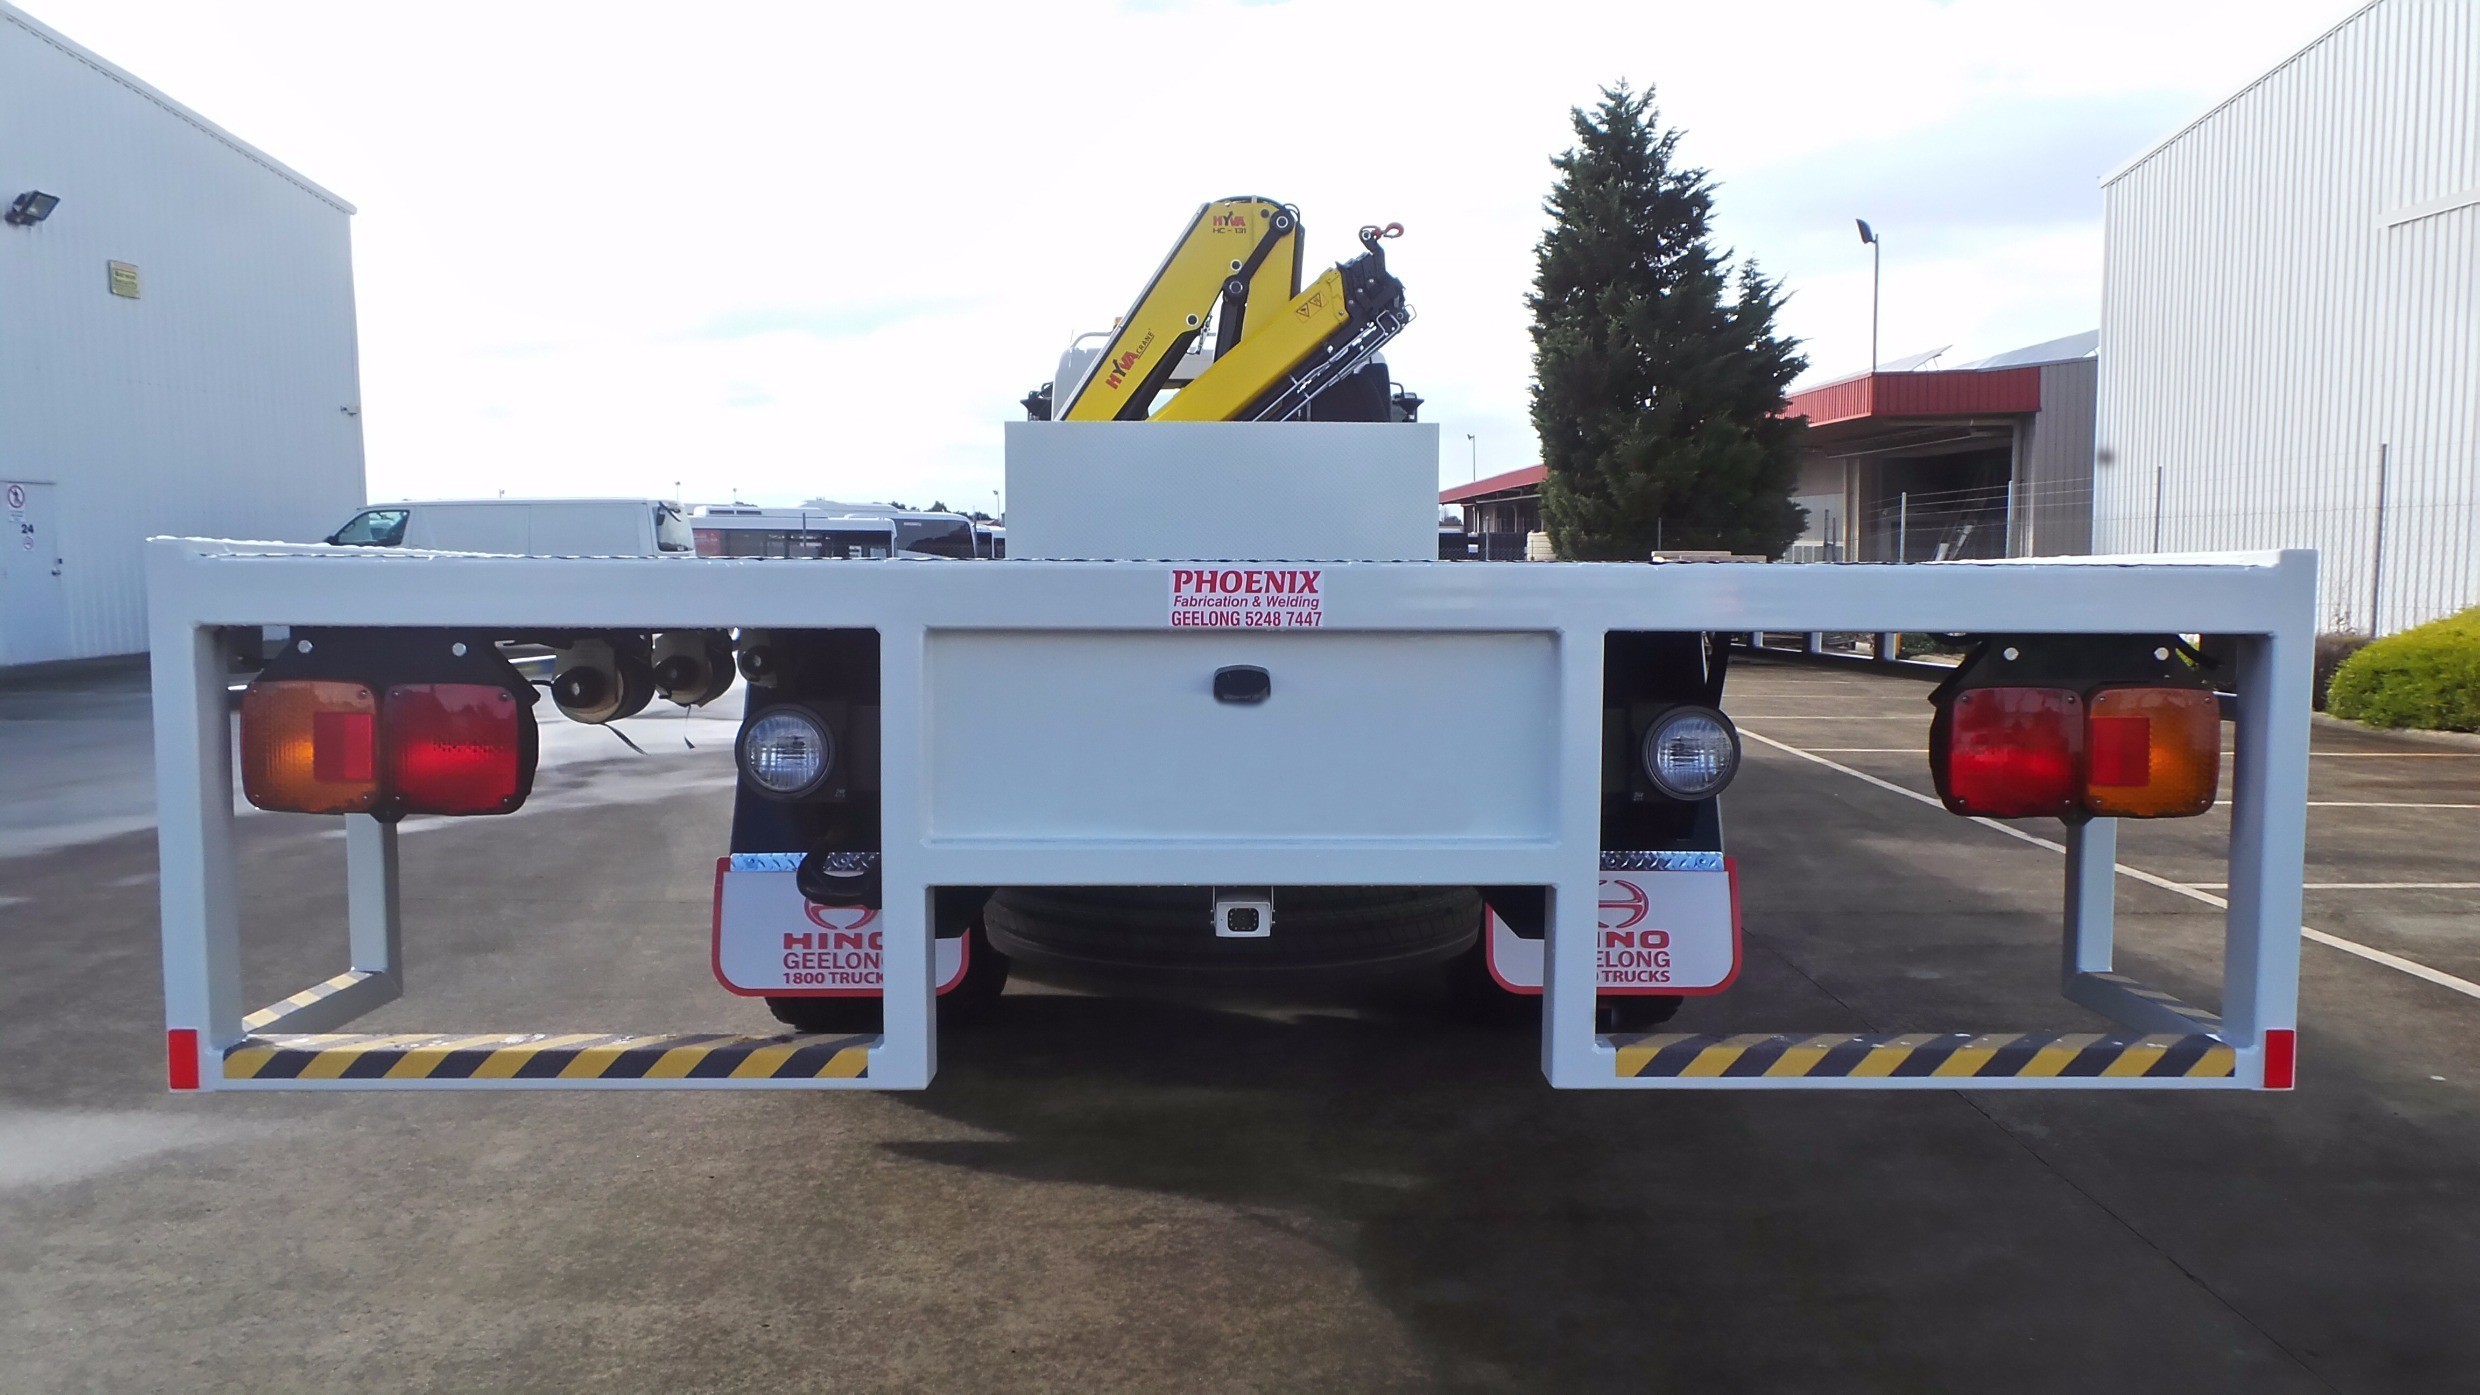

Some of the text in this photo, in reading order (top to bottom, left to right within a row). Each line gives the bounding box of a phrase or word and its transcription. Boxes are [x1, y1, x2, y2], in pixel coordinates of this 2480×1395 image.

[1213, 211, 1246, 226] HYVA
[1105, 330, 1154, 390] HYVA CRANE
[21, 523, 34, 534] 24
[1172, 570, 1322, 594] PHOENIX
[1173, 595, 1320, 610] Fabrication & Welding
[1171, 610, 1322, 627] GEELONG 5248 7447
[1597, 930, 1670, 949] NO
[783, 952, 883, 969] GEELON
[1597, 950, 1671, 968] ELONG
[783, 972, 884, 984] 1800 TRUCK
[1602, 970, 1671, 982] TRUCKS
